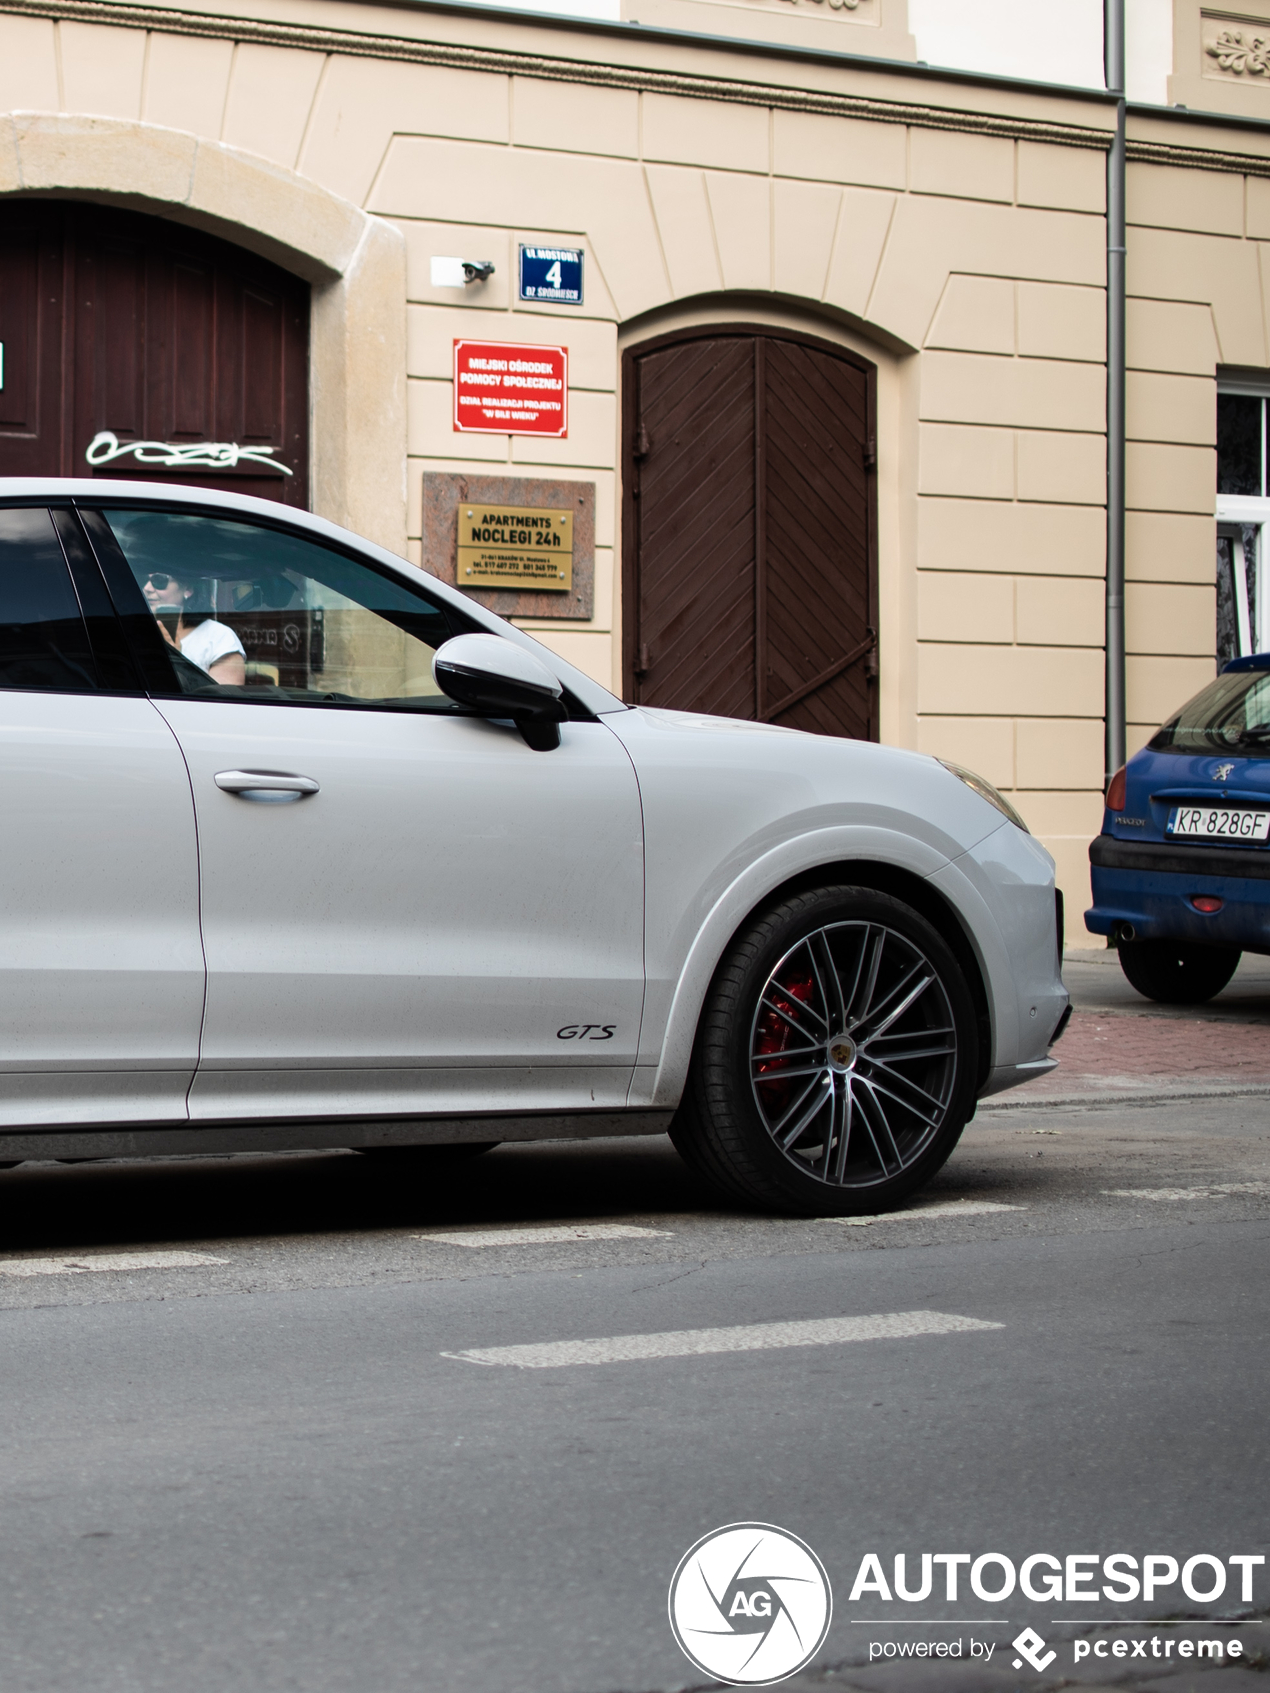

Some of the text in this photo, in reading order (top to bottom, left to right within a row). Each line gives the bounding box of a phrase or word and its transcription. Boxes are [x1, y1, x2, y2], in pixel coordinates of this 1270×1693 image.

[545, 261, 562, 289] 4
[469, 358, 553, 374] MIEJSKI OŚRODEK
[460, 372, 562, 390] POMOCY SPOŁECZNEJ
[482, 397, 523, 408] REALIZACJI
[524, 400, 561, 411] PROJEKTU
[482, 514, 551, 528] APARTMENTS
[472, 527, 561, 546] NOCLEGI 24h
[1177, 810, 1266, 836] KR 828GF
[557, 1025, 617, 1039] GTS
